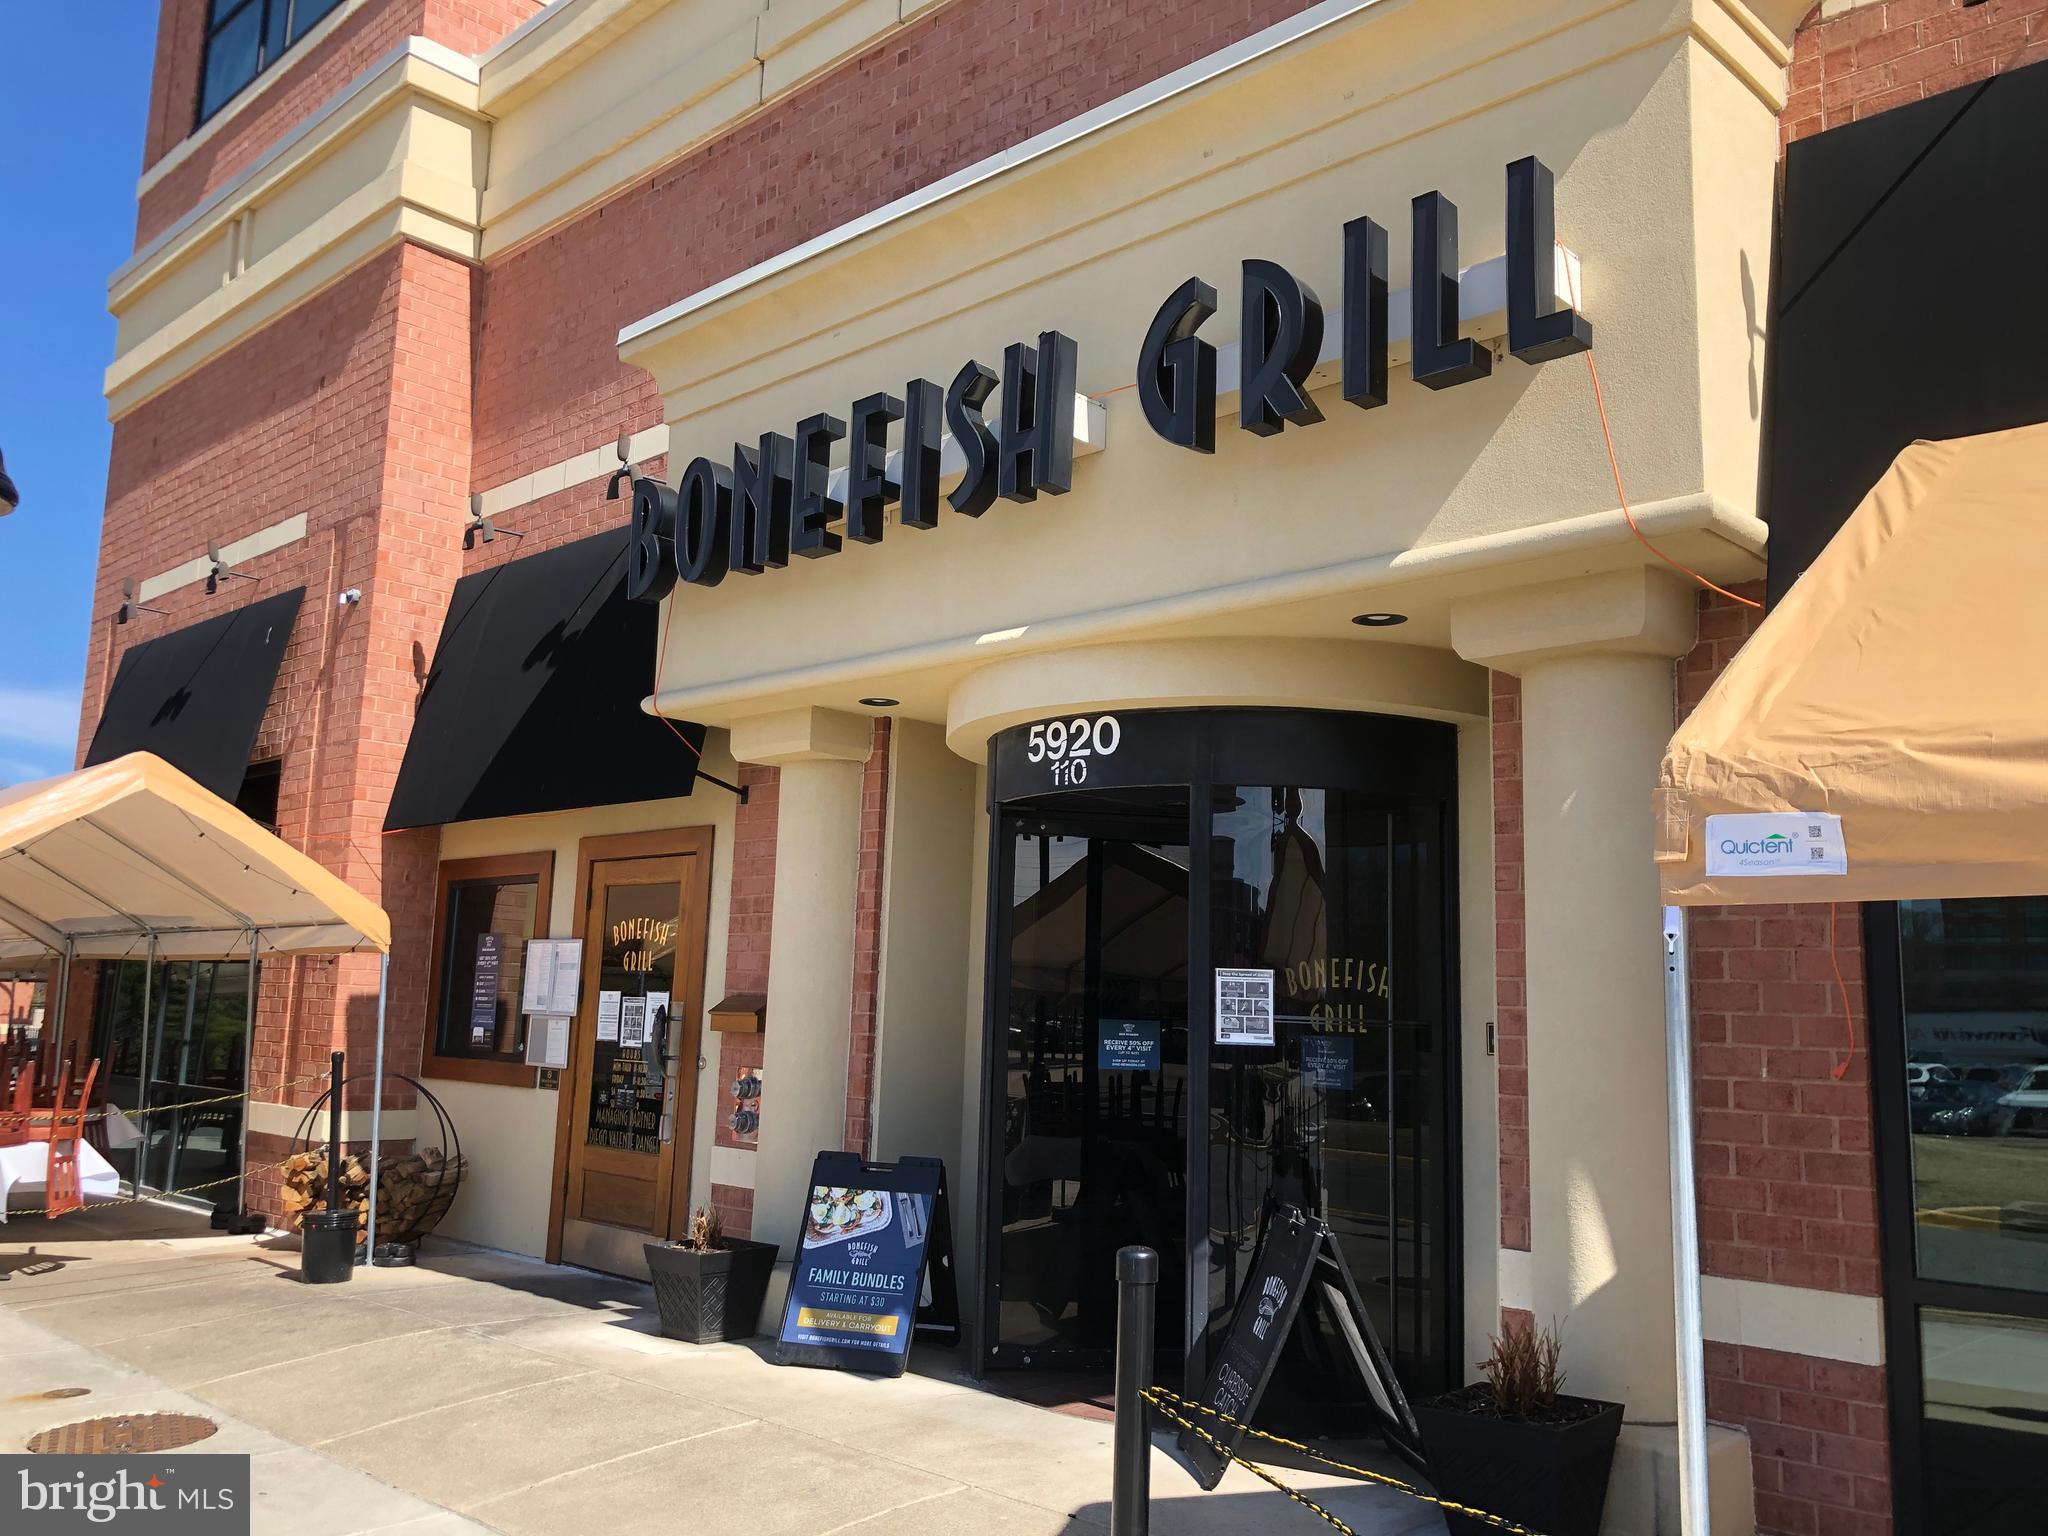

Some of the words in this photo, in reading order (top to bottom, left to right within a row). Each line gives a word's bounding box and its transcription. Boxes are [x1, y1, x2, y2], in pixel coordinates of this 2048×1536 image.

[628, 329, 1079, 601] BONEFISH
[1136, 154, 1594, 455] GRILL
[1027, 715, 1121, 763] 5920
[1050, 758, 1088, 786] 110
[1720, 838, 1793, 855] Quictent
[613, 917, 670, 947] BONEFISH
[623, 950, 653, 972] GRILL
[1284, 958, 1389, 999] BONEFISH
[1310, 1003, 1367, 1033] GRILL
[847, 1241, 879, 1254] BONEFISH
[851, 1257, 868, 1266] GRILL
[808, 1267, 850, 1286] FAMILY
[851, 1271, 905, 1291] BUNDLES
[820, 1291, 858, 1305] STARTING
[858, 1295, 869, 1306] AT
[870, 1296, 886, 1308] $30
[803, 1316, 841, 1328] DELIVERY
[848, 1321, 893, 1333] CARRYOUT
[825, 1312, 857, 1321] AVAILABLE
[1219, 1363, 1254, 1407] CURBSIDE
[1214, 1387, 1241, 1417] CATCH
